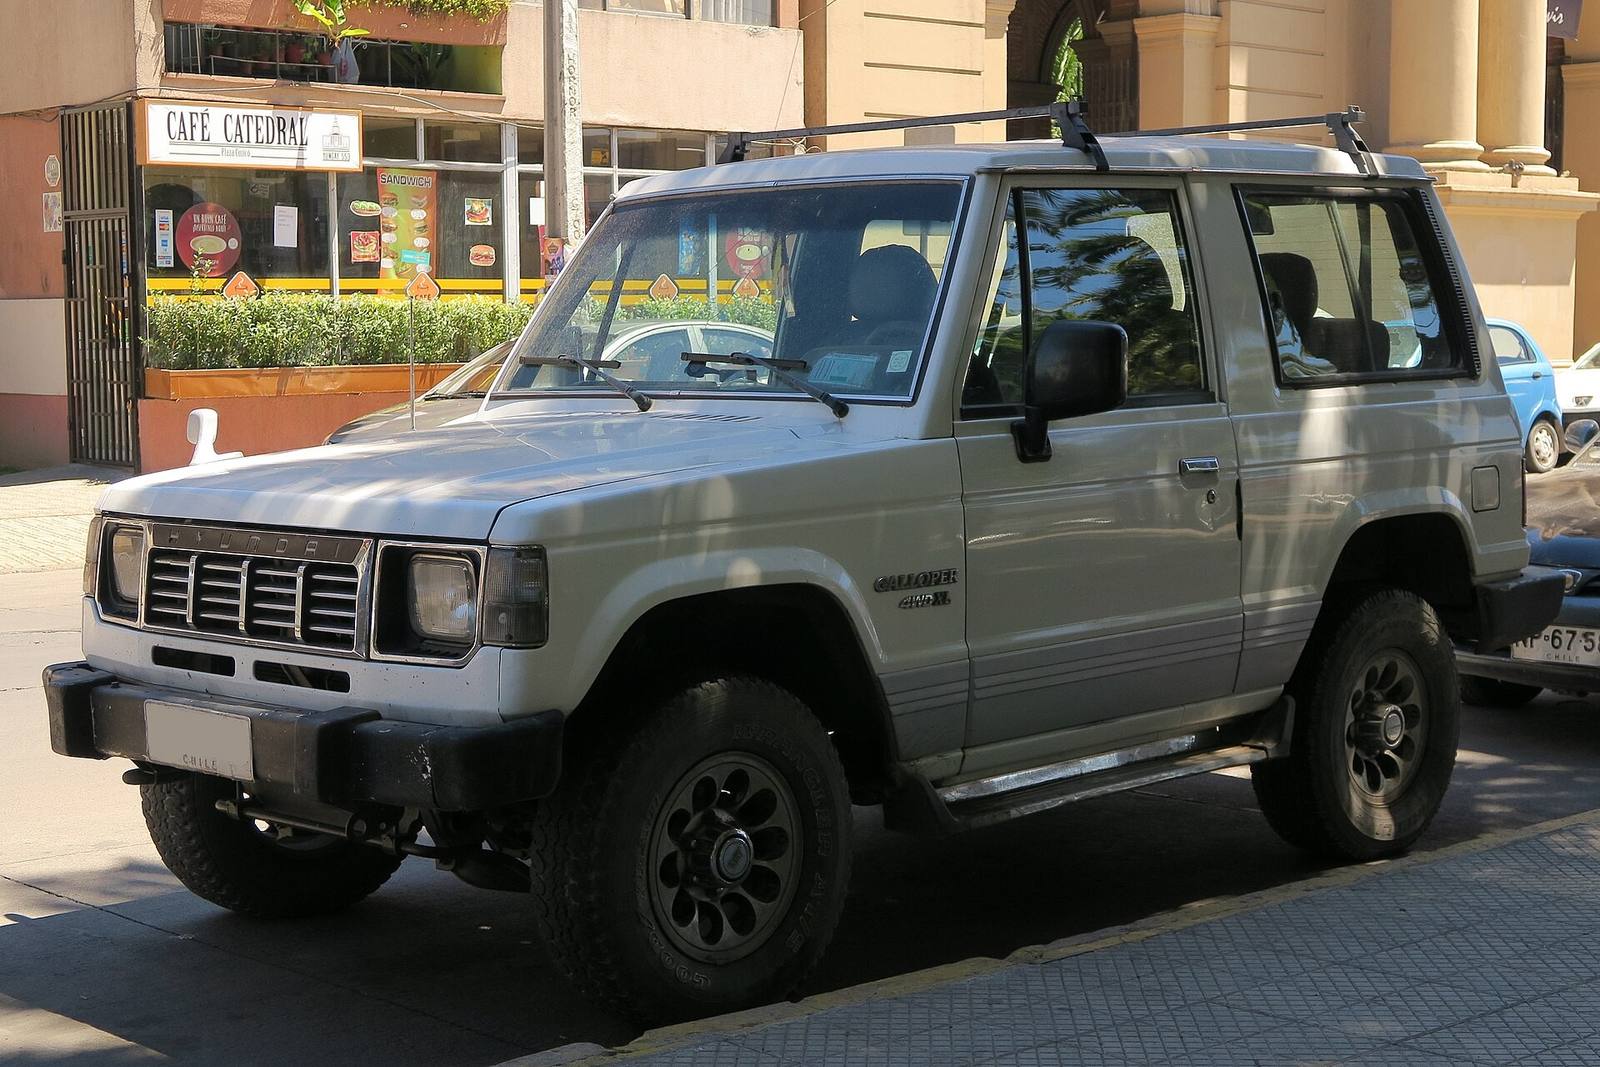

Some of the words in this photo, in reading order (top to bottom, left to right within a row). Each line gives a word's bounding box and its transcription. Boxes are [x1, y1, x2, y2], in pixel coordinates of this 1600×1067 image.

[167, 108, 210, 142] CAFÉ
[224, 113, 309, 146] CATEDRAL
[381, 173, 432, 188] SANDWICH
[168, 528, 341, 560] HYUNDAI
[873, 567, 960, 593] GALLOPER
[1546, 653, 1580, 662] CHILE
[182, 754, 217, 771] CHILE
